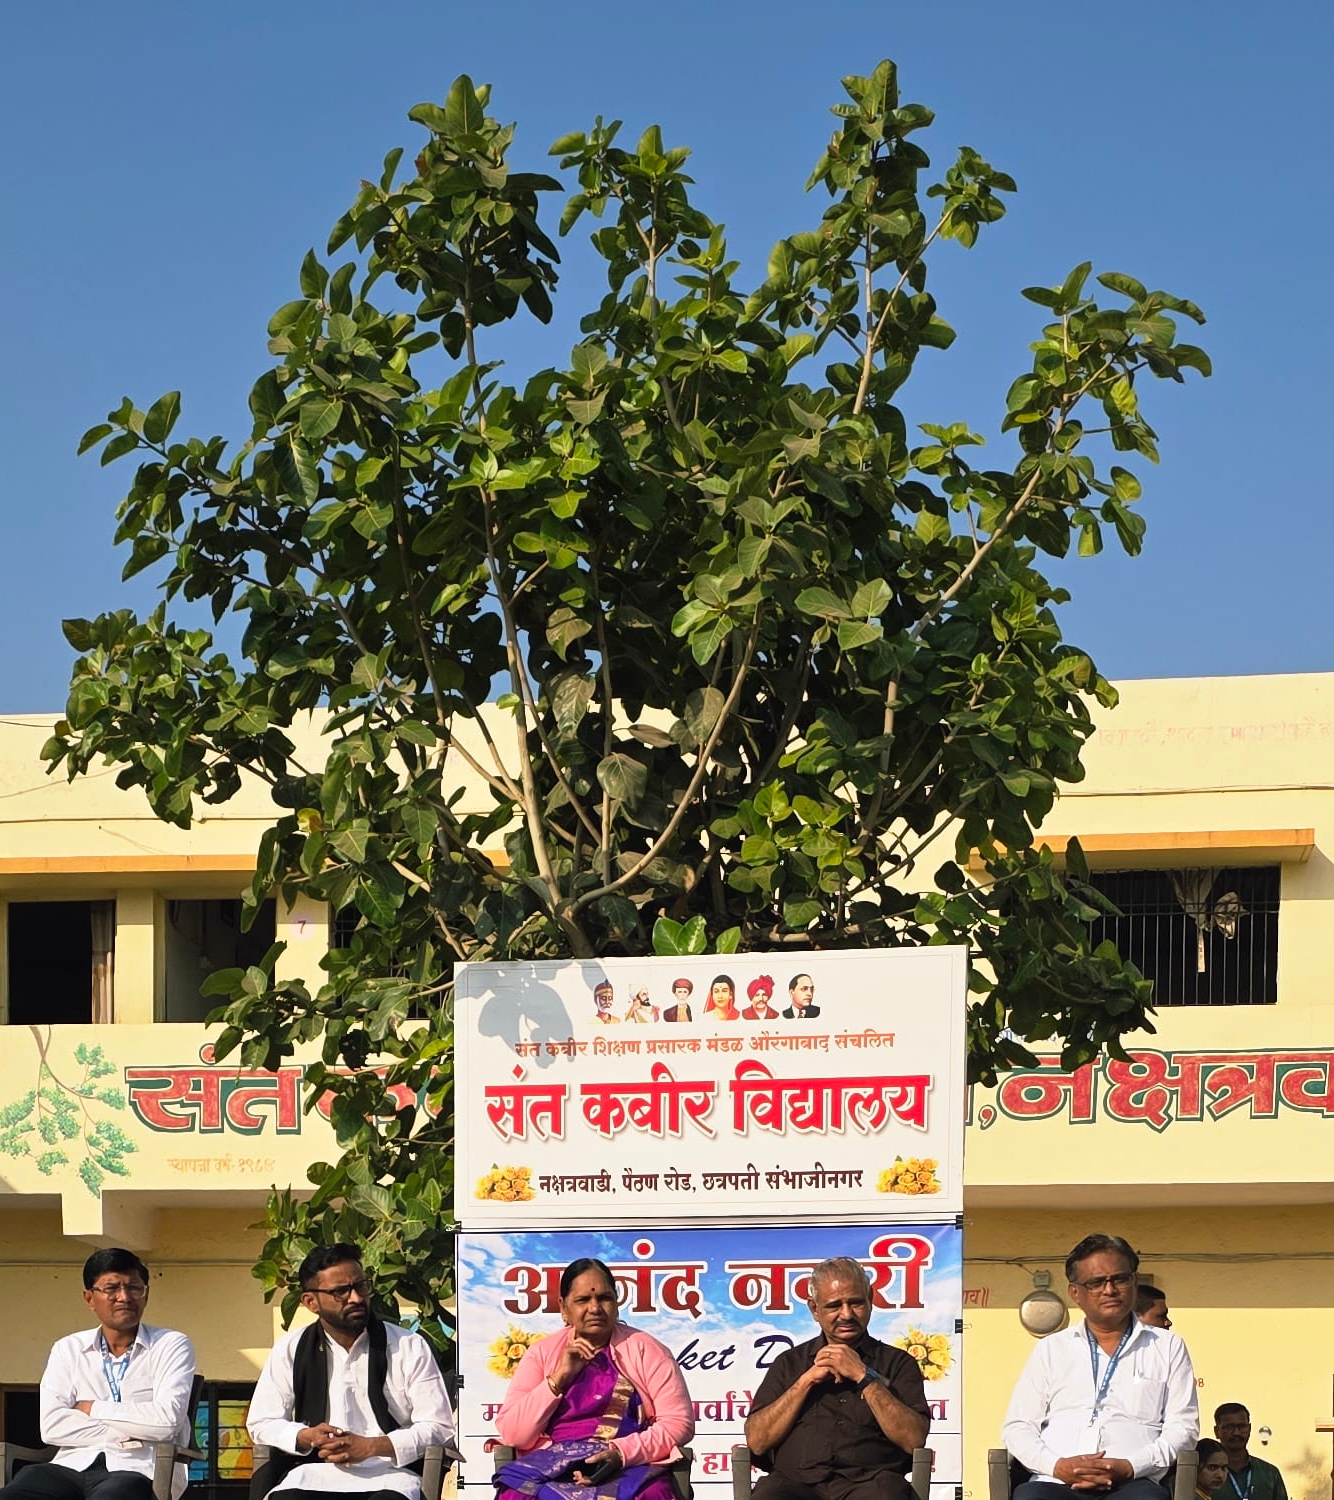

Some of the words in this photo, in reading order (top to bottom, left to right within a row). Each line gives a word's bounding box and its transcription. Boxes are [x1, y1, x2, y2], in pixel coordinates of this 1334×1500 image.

[297, 920, 308, 934] 7
[515, 1038, 540, 1058] संत
[546, 1036, 588, 1056] कबीर
[593, 1036, 640, 1057] शिक्षण
[646, 1038, 701, 1055] प्रसारक
[706, 1034, 743, 1054] मंडळ
[750, 1031, 829, 1054] औरंगाबाद
[834, 1028, 895, 1051] संचलित
[124, 1043, 304, 1135] संत
[484, 1064, 566, 1140] संत
[580, 1062, 715, 1137] कबीर
[729, 1059, 931, 1135] विद्यालय
[539, 1167, 616, 1196] नक्षत्रवाडी,
[621, 1168, 659, 1192] पैठण
[663, 1167, 697, 1195] रोड,
[702, 1166, 759, 1192] छत्रपती
[765, 1162, 863, 1190] संभाजीनगर
[677, 1339, 735, 1370] ket
